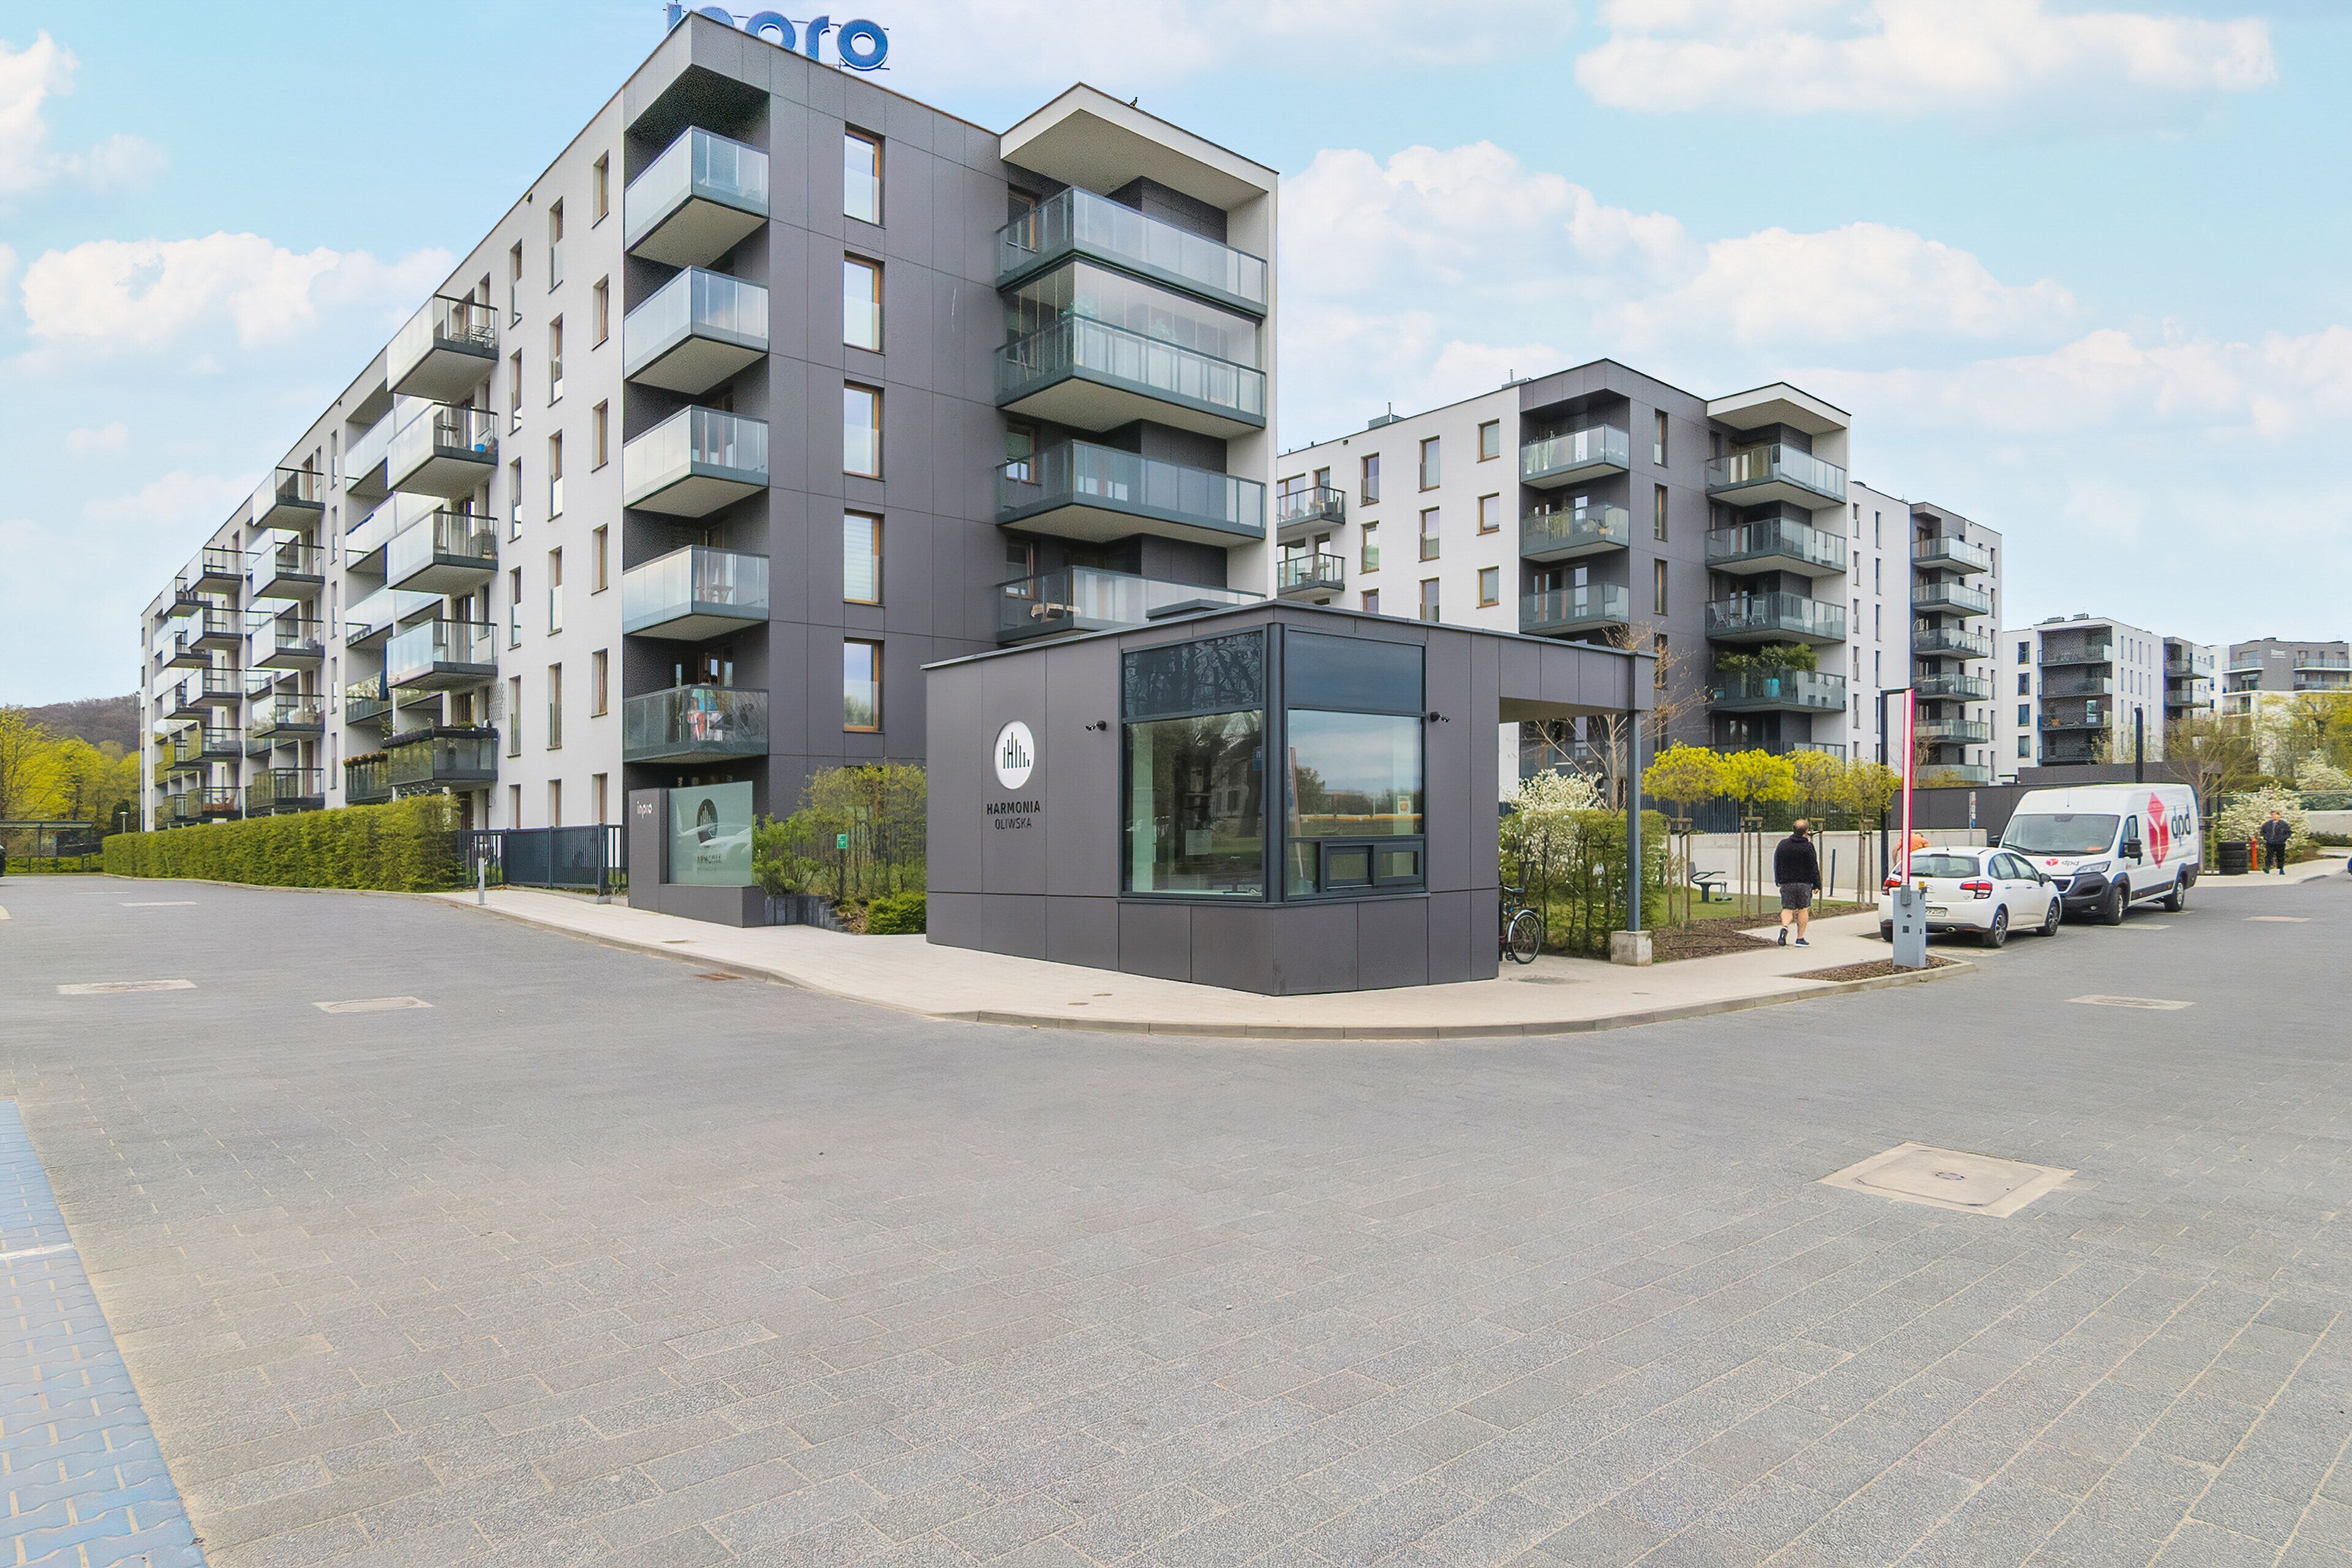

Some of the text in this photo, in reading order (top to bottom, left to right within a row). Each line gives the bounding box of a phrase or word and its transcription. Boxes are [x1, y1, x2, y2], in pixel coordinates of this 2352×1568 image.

[987, 801, 1041, 815] HARMONIA
[995, 818, 1031, 829] OLIWSKA
[2171, 804, 2191, 848] dpd
